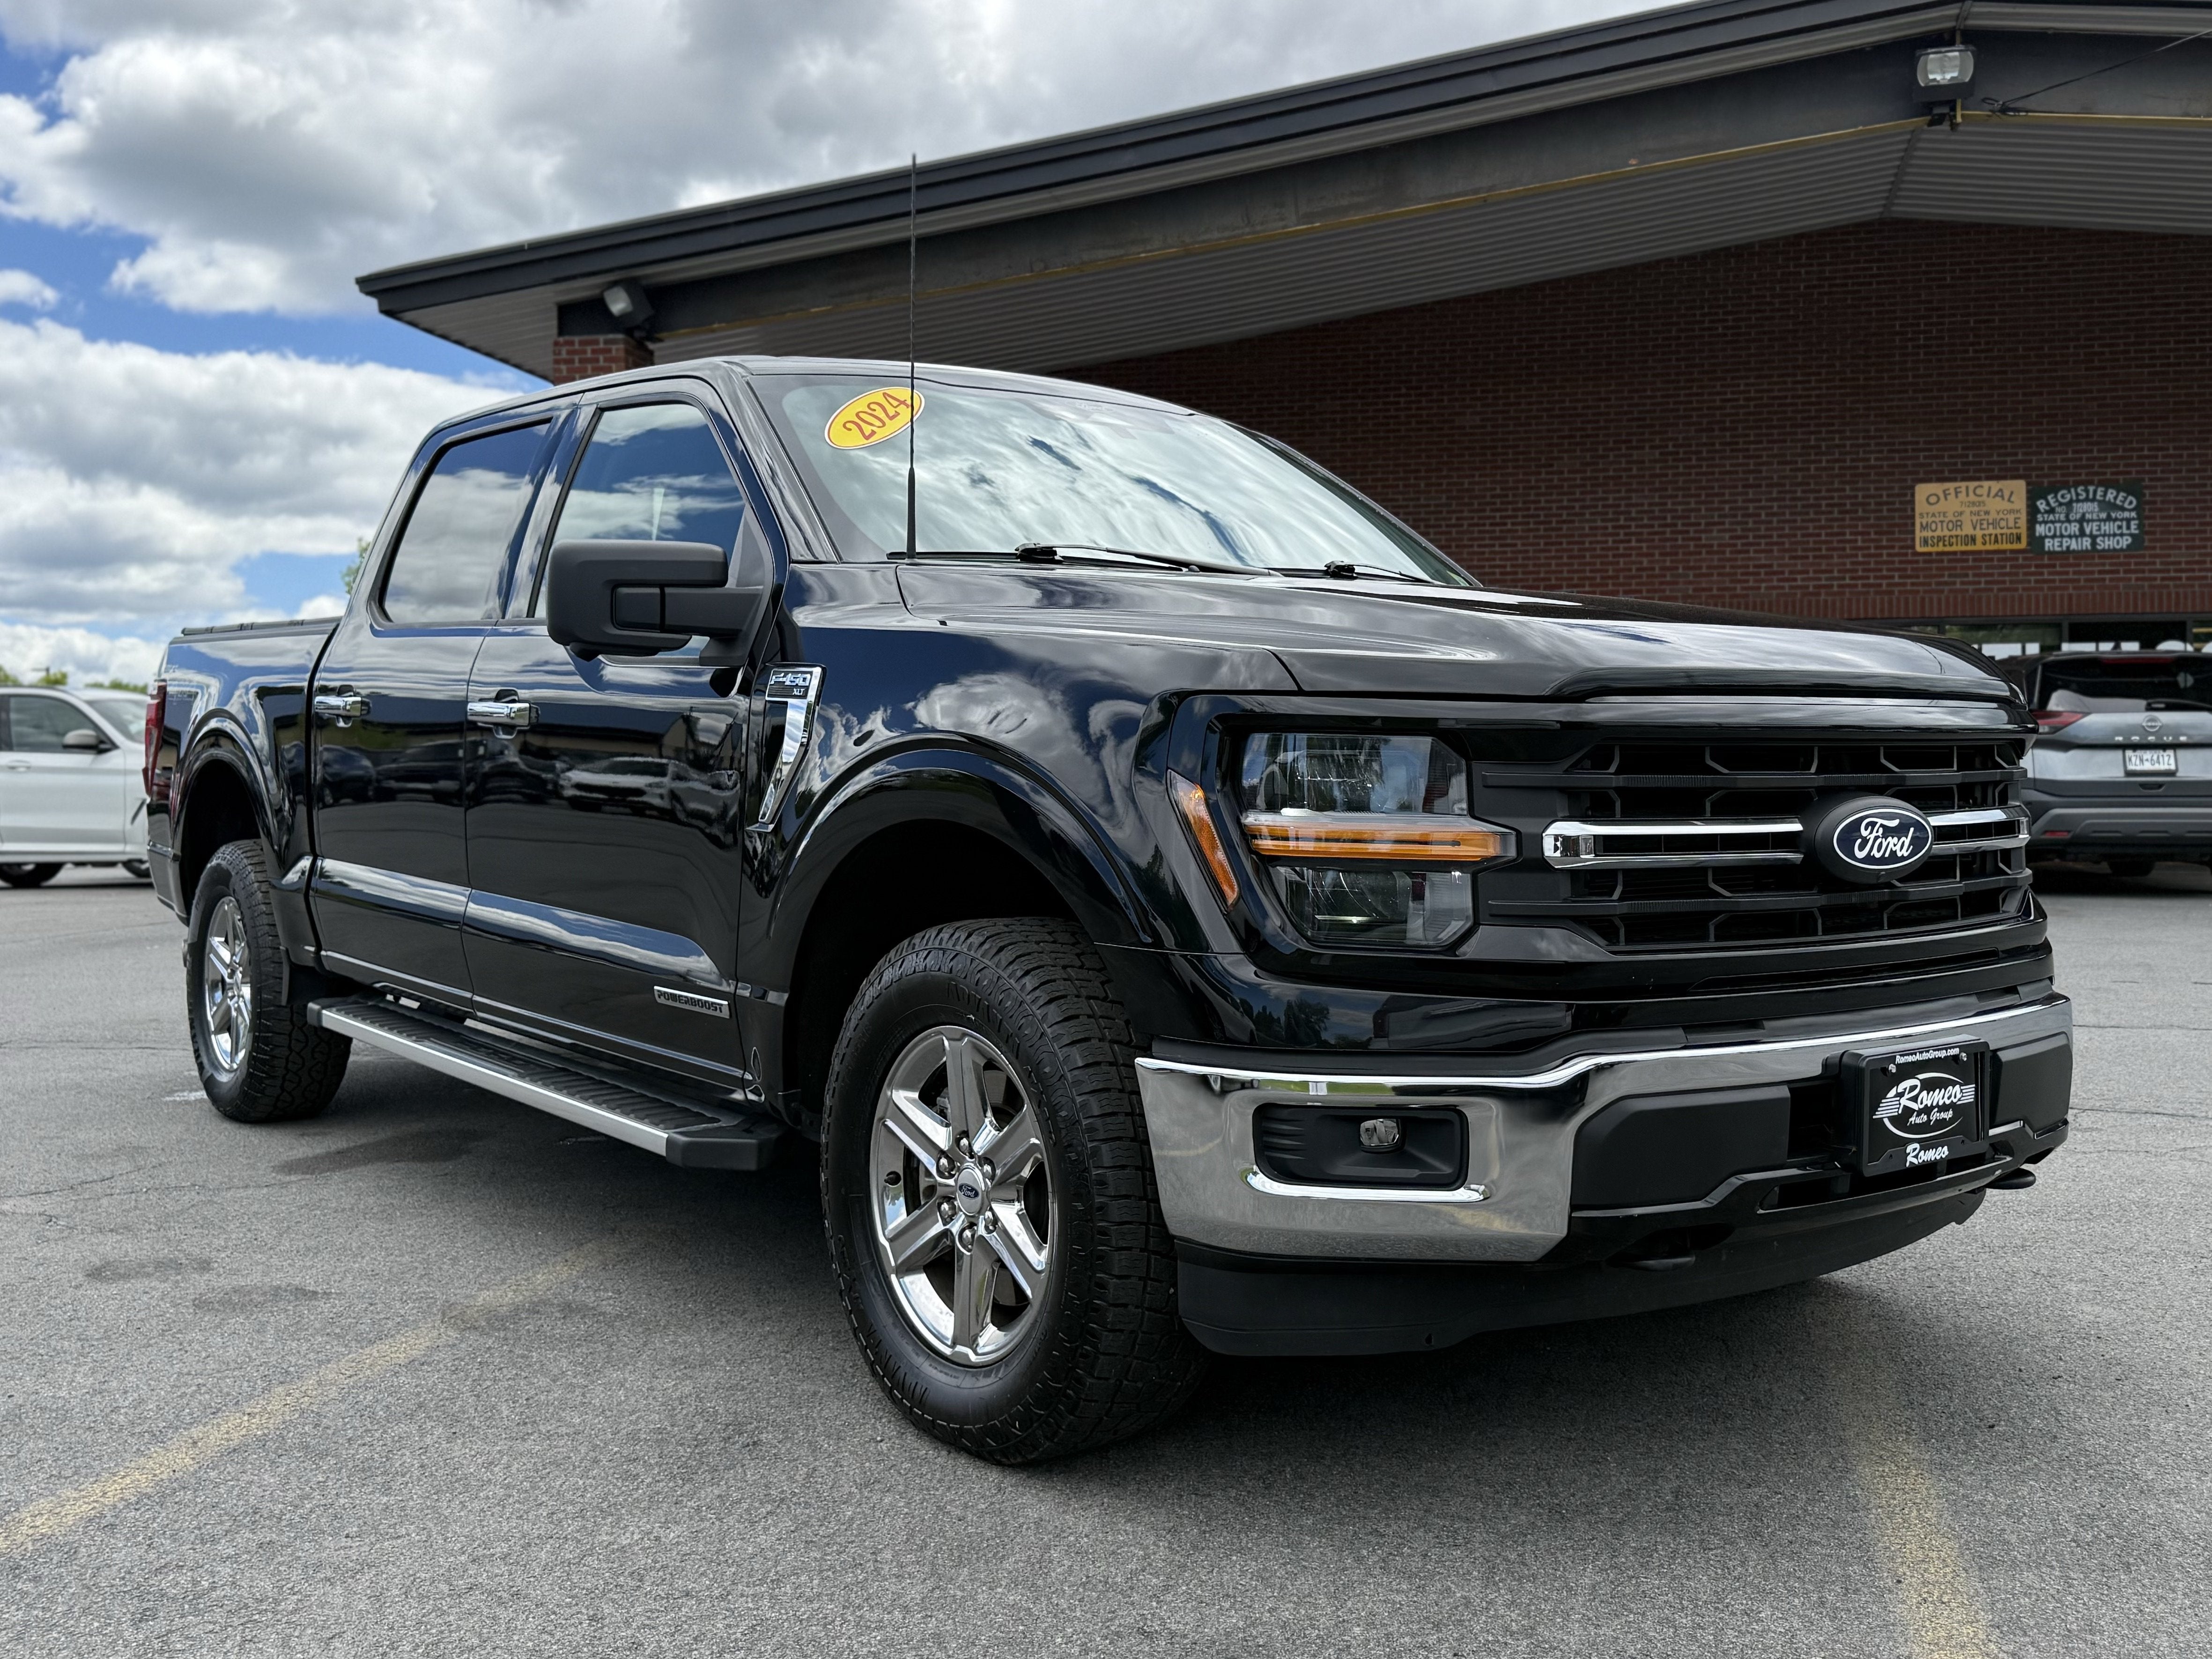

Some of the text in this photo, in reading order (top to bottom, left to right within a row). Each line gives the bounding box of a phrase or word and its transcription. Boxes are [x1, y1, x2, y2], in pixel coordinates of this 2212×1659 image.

[843, 392, 910, 440] 2024
[1925, 485, 2015, 506] OFFICIAL
[2036, 485, 2137, 513] REGISTERED
[1920, 517, 2021, 533] MOTOR VEHICLE
[2035, 520, 2139, 537] MOTOR VEHICLE
[1919, 532, 2022, 548] INSPECTION STATION
[2044, 535, 2132, 552] REPAIR SHOP
[770, 673, 811, 686] F-150
[1854, 817, 1914, 859] Ford
[657, 990, 723, 1013] POWERBOOST
[1895, 1047, 1960, 1065] RomeoAutoGroup.com
[1897, 1078, 1963, 1114] Romeo
[1907, 1108, 1953, 1126] Auto Group
[1906, 1143, 1949, 1167] Romeo
[962, 1185, 976, 1197] Ford
